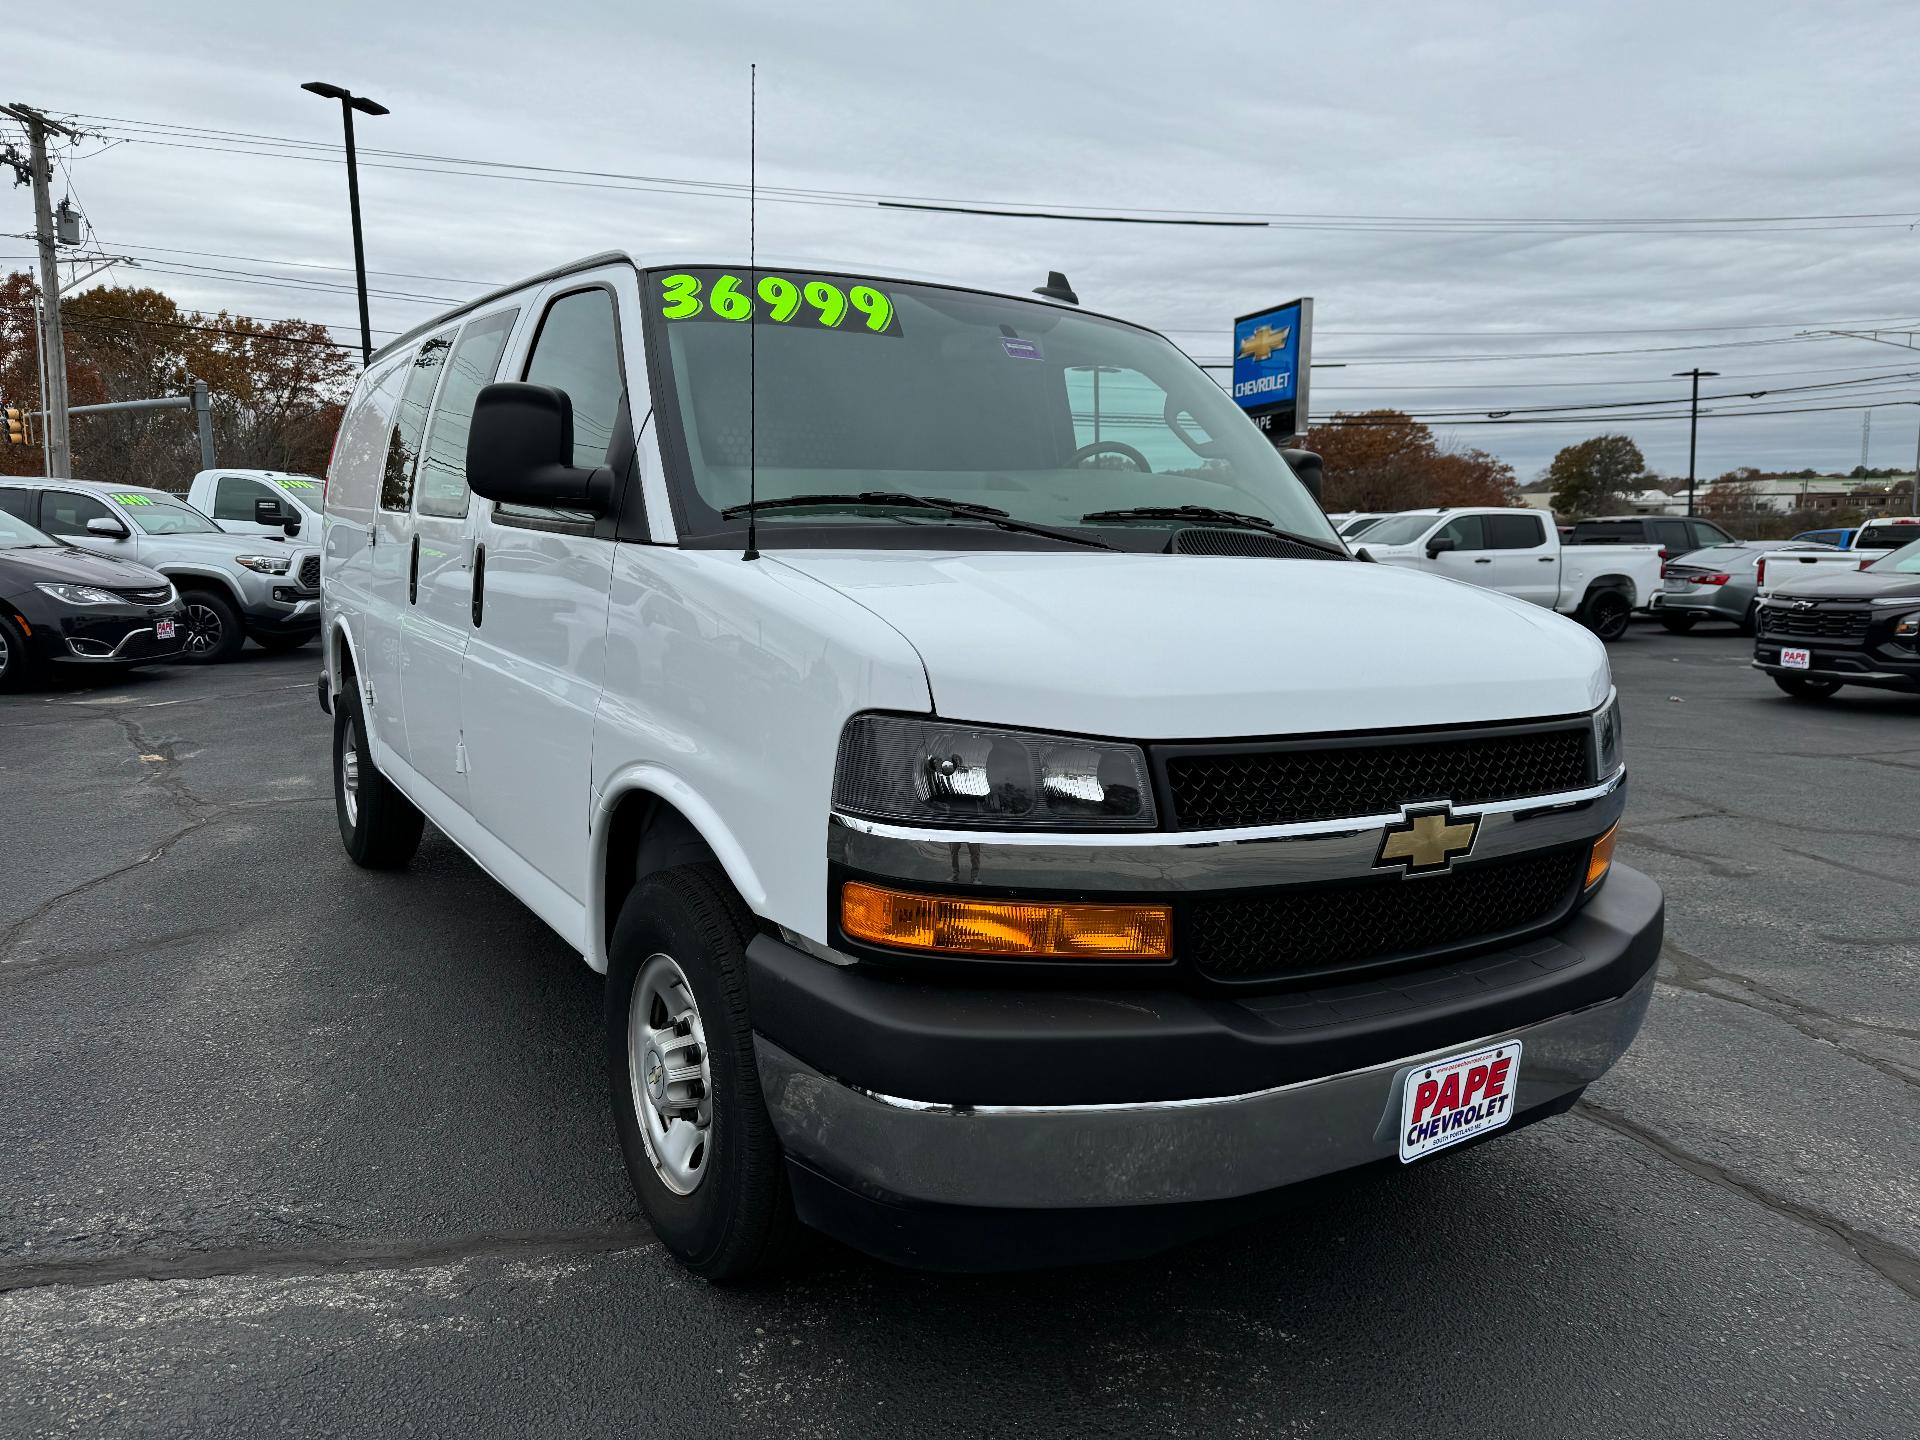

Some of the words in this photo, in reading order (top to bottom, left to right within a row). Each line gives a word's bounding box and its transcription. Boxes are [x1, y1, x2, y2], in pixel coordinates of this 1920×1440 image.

[662, 274, 894, 333] 36999
[1235, 372, 1290, 398] CHEVROLET
[1783, 651, 1807, 661] PAPE
[1411, 1056, 1512, 1125] PAPE
[1406, 1094, 1509, 1147] CHEVROLET
[1433, 1135, 1449, 1146] SOUTH
[1449, 1126, 1474, 1139] PORTLAND
